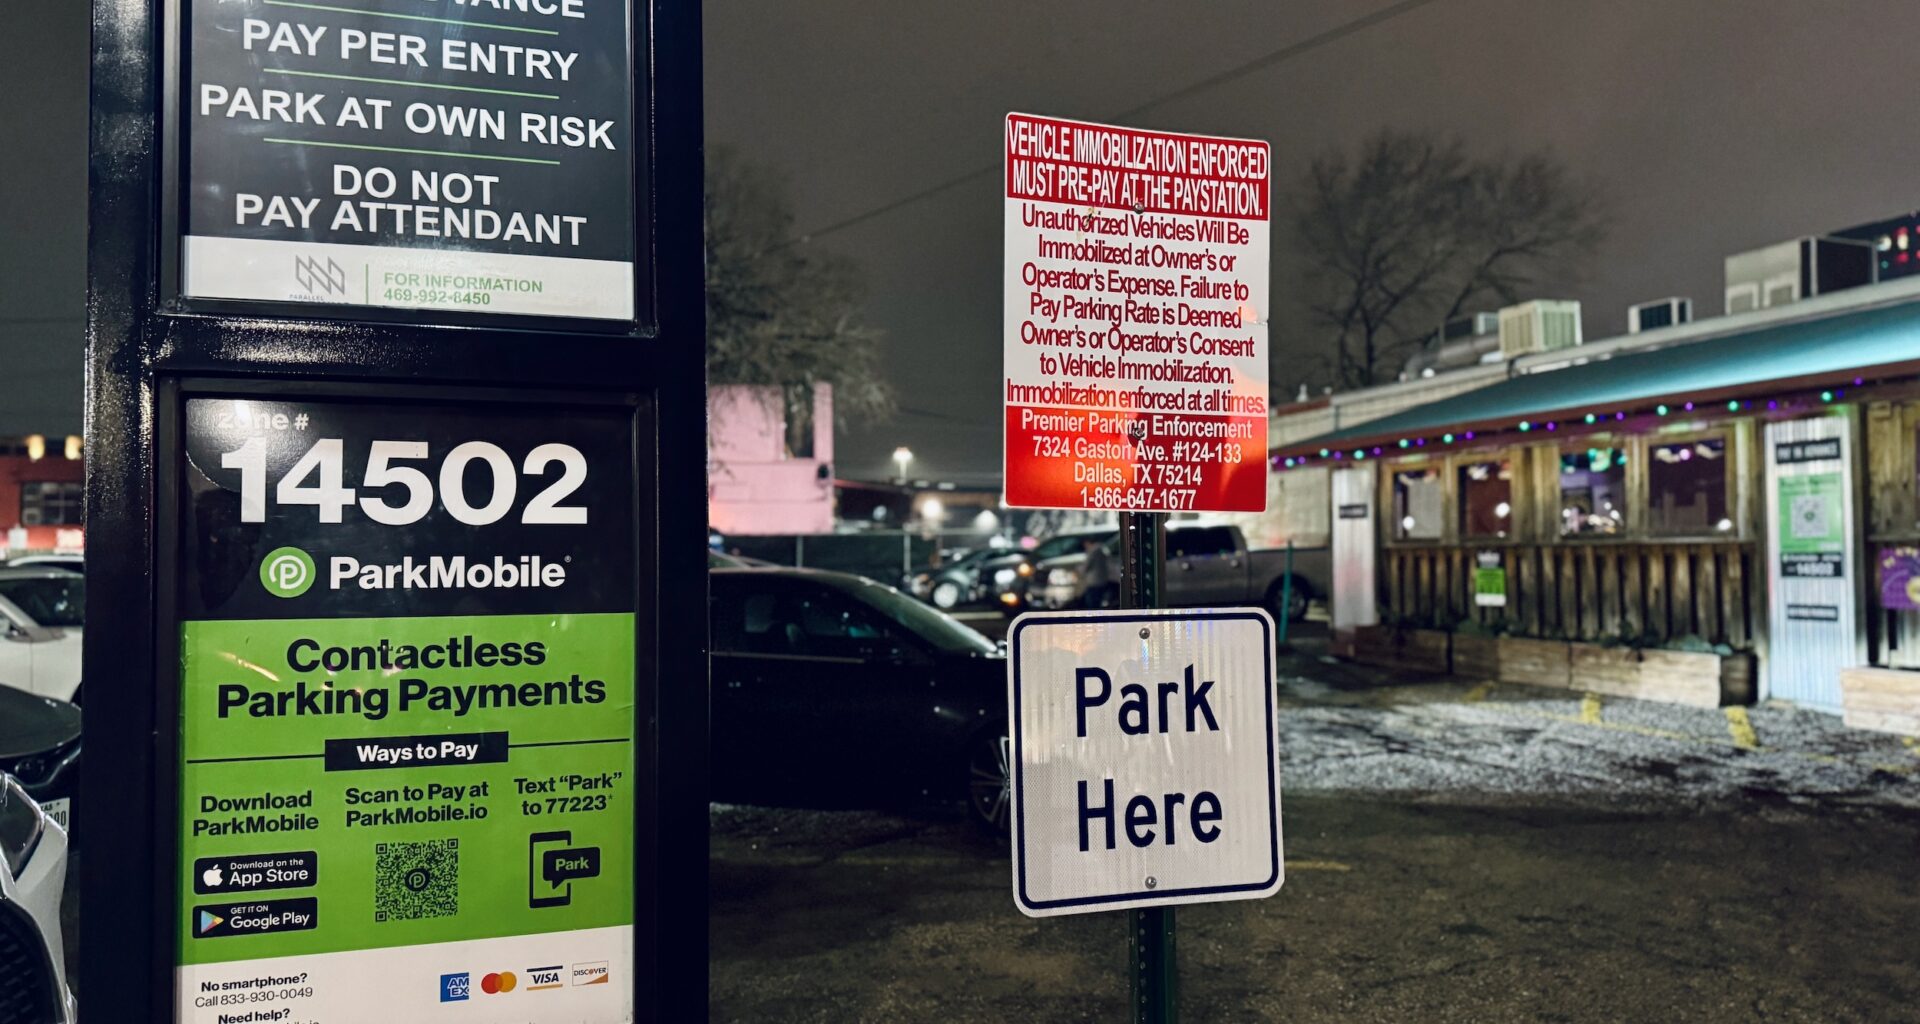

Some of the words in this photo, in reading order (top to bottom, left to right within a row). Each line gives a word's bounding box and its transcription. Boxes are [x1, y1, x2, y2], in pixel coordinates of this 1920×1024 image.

[243, 19, 326, 56] PAY
[340, 28, 429, 68] PER
[442, 40, 579, 81] ENTRY
[200, 84, 326, 125] PARK
[336, 96, 392, 130] AT
[404, 103, 506, 140] OWN
[520, 114, 616, 151] RISK
[1008, 119, 1070, 161] VEHICLE
[1073, 128, 1187, 174] IMMOBILIZATION
[1189, 142, 1267, 180] ENFORCED
[333, 164, 397, 199] DO
[412, 170, 499, 206] NOT
[1013, 159, 1055, 197] MUST
[1058, 165, 1119, 204] PRE-PAY
[1120, 172, 1139, 206] AT
[1142, 174, 1170, 209] THE
[1174, 177, 1263, 216] PAYSTATION.
[235, 193, 321, 230] PAY
[330, 200, 588, 246] ATTENDANT
[1022, 203, 1128, 235] Unauthorized
[1131, 214, 1195, 242] Vehicles
[1197, 219, 1224, 243] Will
[1227, 222, 1249, 245] Be
[1038, 234, 1132, 266] Immobilized
[1135, 248, 1149, 267] at
[1151, 244, 1217, 271] Owner's
[1219, 254, 1236, 272] or
[384, 272, 420, 287] FOR
[426, 274, 543, 293] INFORMATION
[1022, 262, 1105, 293] Operator's
[1107, 269, 1178, 299] Expense.
[1180, 275, 1232, 299] Failure
[1234, 280, 1249, 301] to
[384, 288, 491, 305] 469-992-8450
[1030, 292, 1060, 323] Pay
[1063, 295, 1121, 326] Parking
[1125, 299, 1159, 324] Rate
[1163, 302, 1175, 325] is
[1178, 303, 1242, 329] Deemed
[1021, 320, 1086, 347] Owner's
[1089, 333, 1106, 349] or
[1107, 324, 1187, 356] Operator's
[1190, 332, 1255, 357] Consent
[1040, 352, 1057, 375] to
[1058, 352, 1116, 379] Vehicle
[1118, 356, 1234, 385] Immobilization.
[1007, 378, 1116, 408] Immobilization
[1119, 386, 1185, 411] enforced
[1188, 394, 1202, 411] at
[1204, 389, 1219, 412] all
[1222, 390, 1266, 414] times.
[1022, 409, 1084, 433] Premier
[1088, 412, 1148, 440] Parking
[1152, 416, 1252, 439] Enforcement
[1033, 436, 1070, 457] 7324
[1075, 437, 1131, 459] Gaston
[1134, 440, 1169, 461] Ave.
[1172, 442, 1242, 463] #124-133
[221, 438, 588, 526] 14502
[1075, 462, 1127, 487] Dallas,
[1130, 464, 1152, 484] TX
[1156, 465, 1202, 486] 75214
[1080, 488, 1197, 510] 1-866-647-1677
[287, 636, 546, 672] Contactless
[218, 681, 389, 719] Parking
[399, 674, 606, 717] Payments
[1075, 663, 1220, 738] Park
[357, 745, 413, 764] Ways
[416, 744, 437, 760] to
[441, 742, 478, 761] Pay
[345, 787, 399, 805] Scan
[403, 786, 424, 802] to
[428, 783, 465, 801] Pay
[471, 781, 489, 798] at
[514, 776, 556, 795] Text
[201, 790, 312, 813] Download
[522, 800, 542, 816] to
[193, 813, 319, 836] ParkMobile
[346, 804, 488, 827] ParkMobile.io
[1077, 778, 1222, 852] Here
[230, 859, 274, 870] Download
[289, 858, 304, 866] the
[555, 856, 590, 871] Park
[229, 871, 262, 887] App
[266, 869, 308, 883] Store
[230, 914, 280, 930] Google
[283, 912, 310, 927] Play
[256, 905, 269, 913] ON
[201, 982, 220, 992] No
[222, 972, 308, 990] smartphone?
[532, 972, 559, 984] VISA
[573, 967, 607, 977] DISCOVER
[195, 995, 218, 1008] Call
[220, 986, 313, 1006] 833-930-0049
[218, 1012, 252, 1024] Need
[255, 1008, 290, 1022] help?
